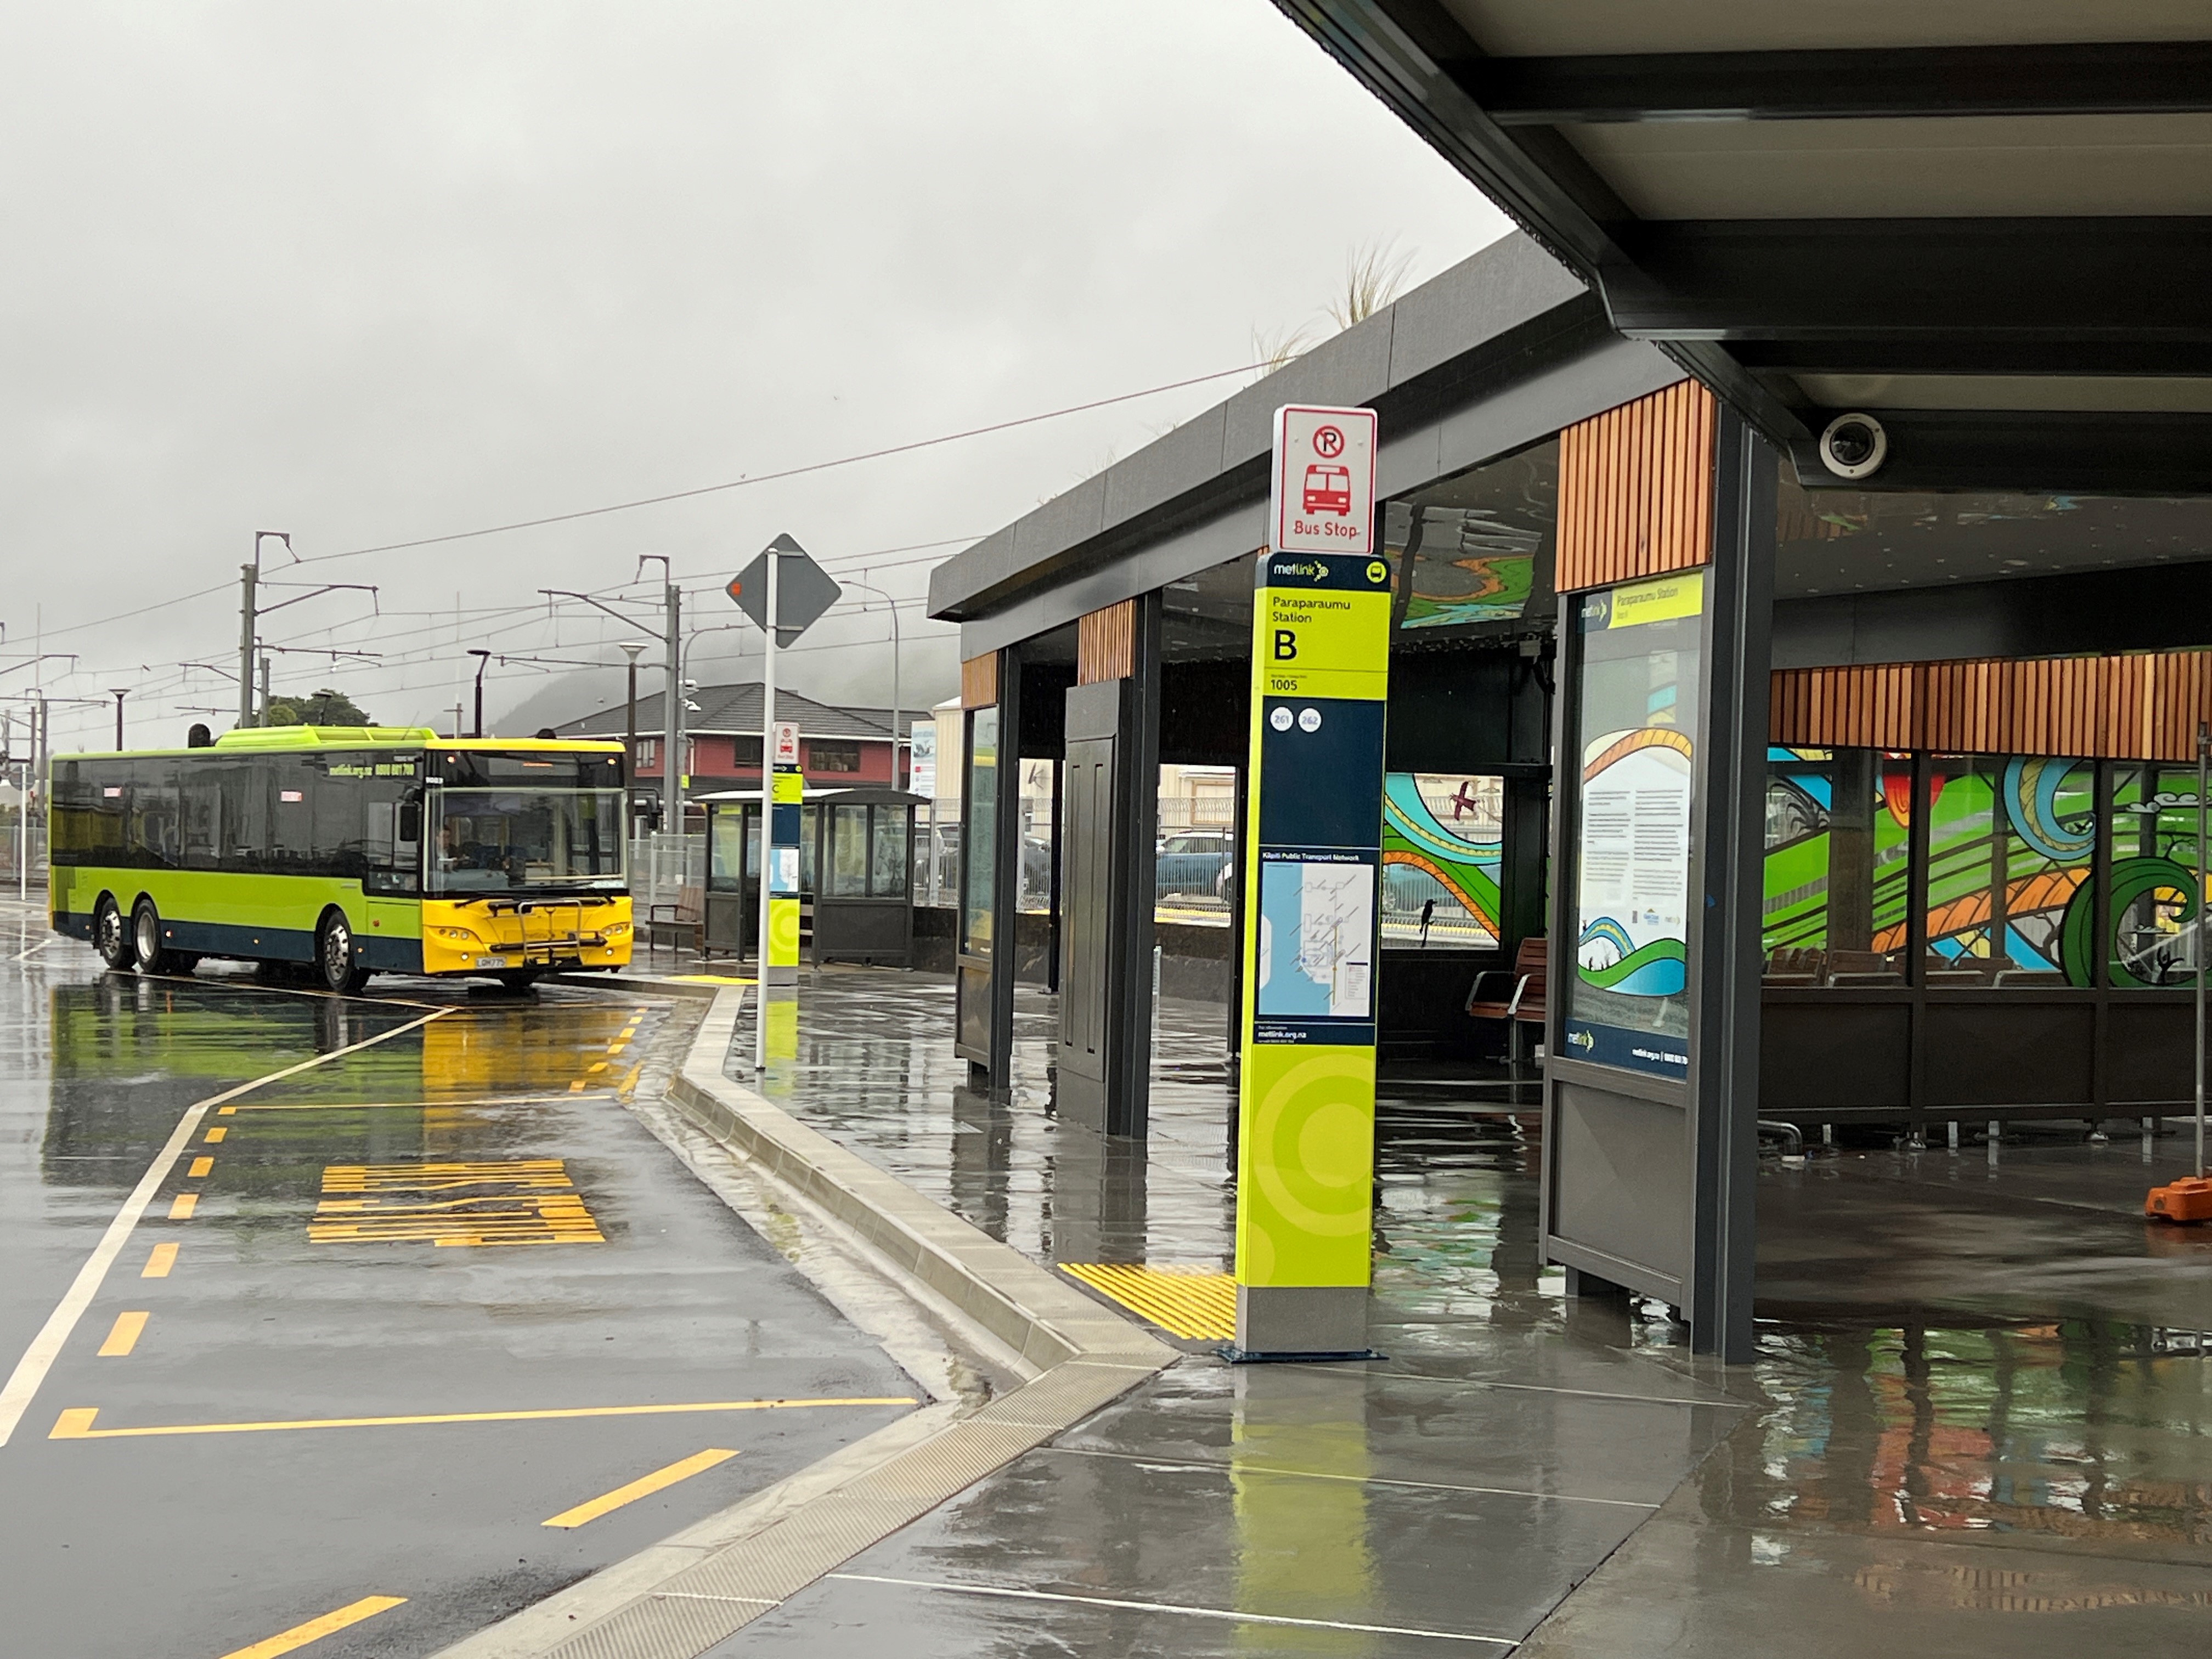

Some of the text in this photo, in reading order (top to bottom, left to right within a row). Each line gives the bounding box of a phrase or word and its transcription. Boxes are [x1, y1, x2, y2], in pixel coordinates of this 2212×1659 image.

[1295, 520, 1357, 540] Bus Stop
[1273, 563, 1315, 575] metlink
[1657, 588, 1678, 599] Station
[1272, 596, 1351, 611] Paraparaumu
[1272, 611, 1312, 623] Station
[1274, 629, 1297, 661] B
[1271, 679, 1298, 691] 1005
[1274, 714, 1290, 724] 261
[1302, 715, 1318, 725] 262
[1282, 851, 1301, 860] Public
[1302, 853, 1332, 861] Transport
